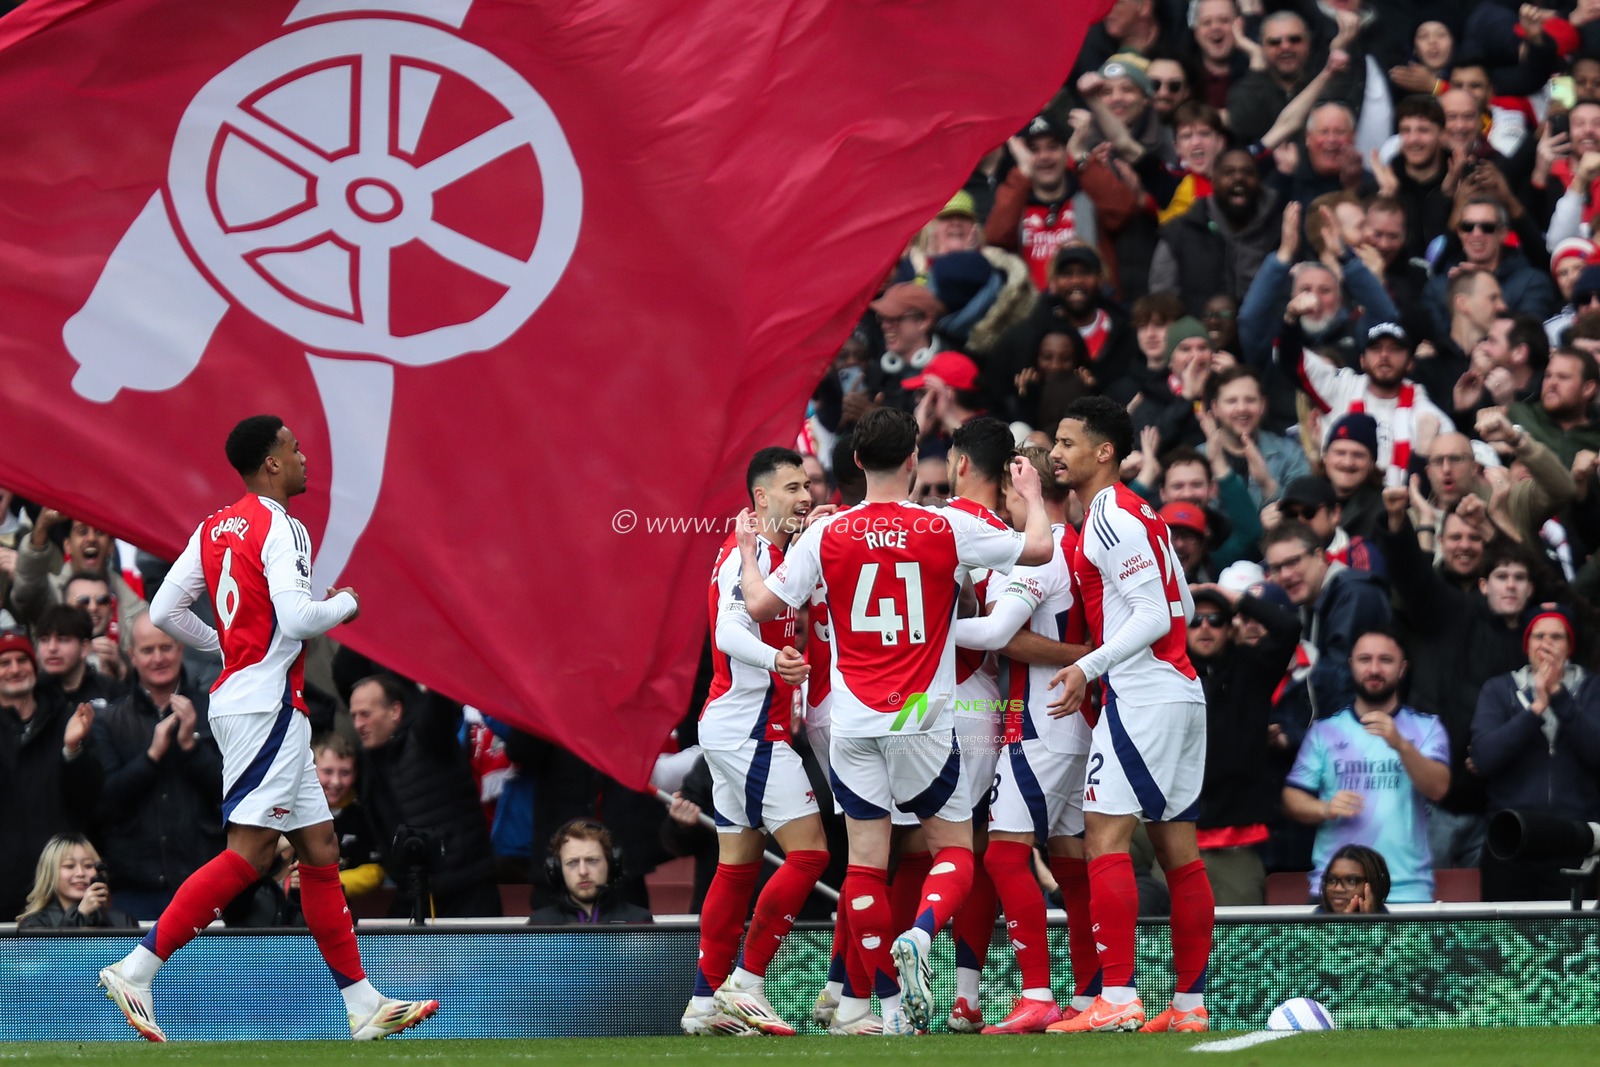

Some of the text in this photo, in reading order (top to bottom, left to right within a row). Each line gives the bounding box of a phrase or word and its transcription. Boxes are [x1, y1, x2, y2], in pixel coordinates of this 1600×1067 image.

[865, 530, 908, 550] RICE
[1119, 558, 1155, 581] RWANDA
[1122, 553, 1143, 569] VISIT
[216, 547, 240, 631] 6
[851, 561, 927, 646] 41
[1087, 752, 1105, 786] 2
[1334, 757, 1405, 776] Emirate
